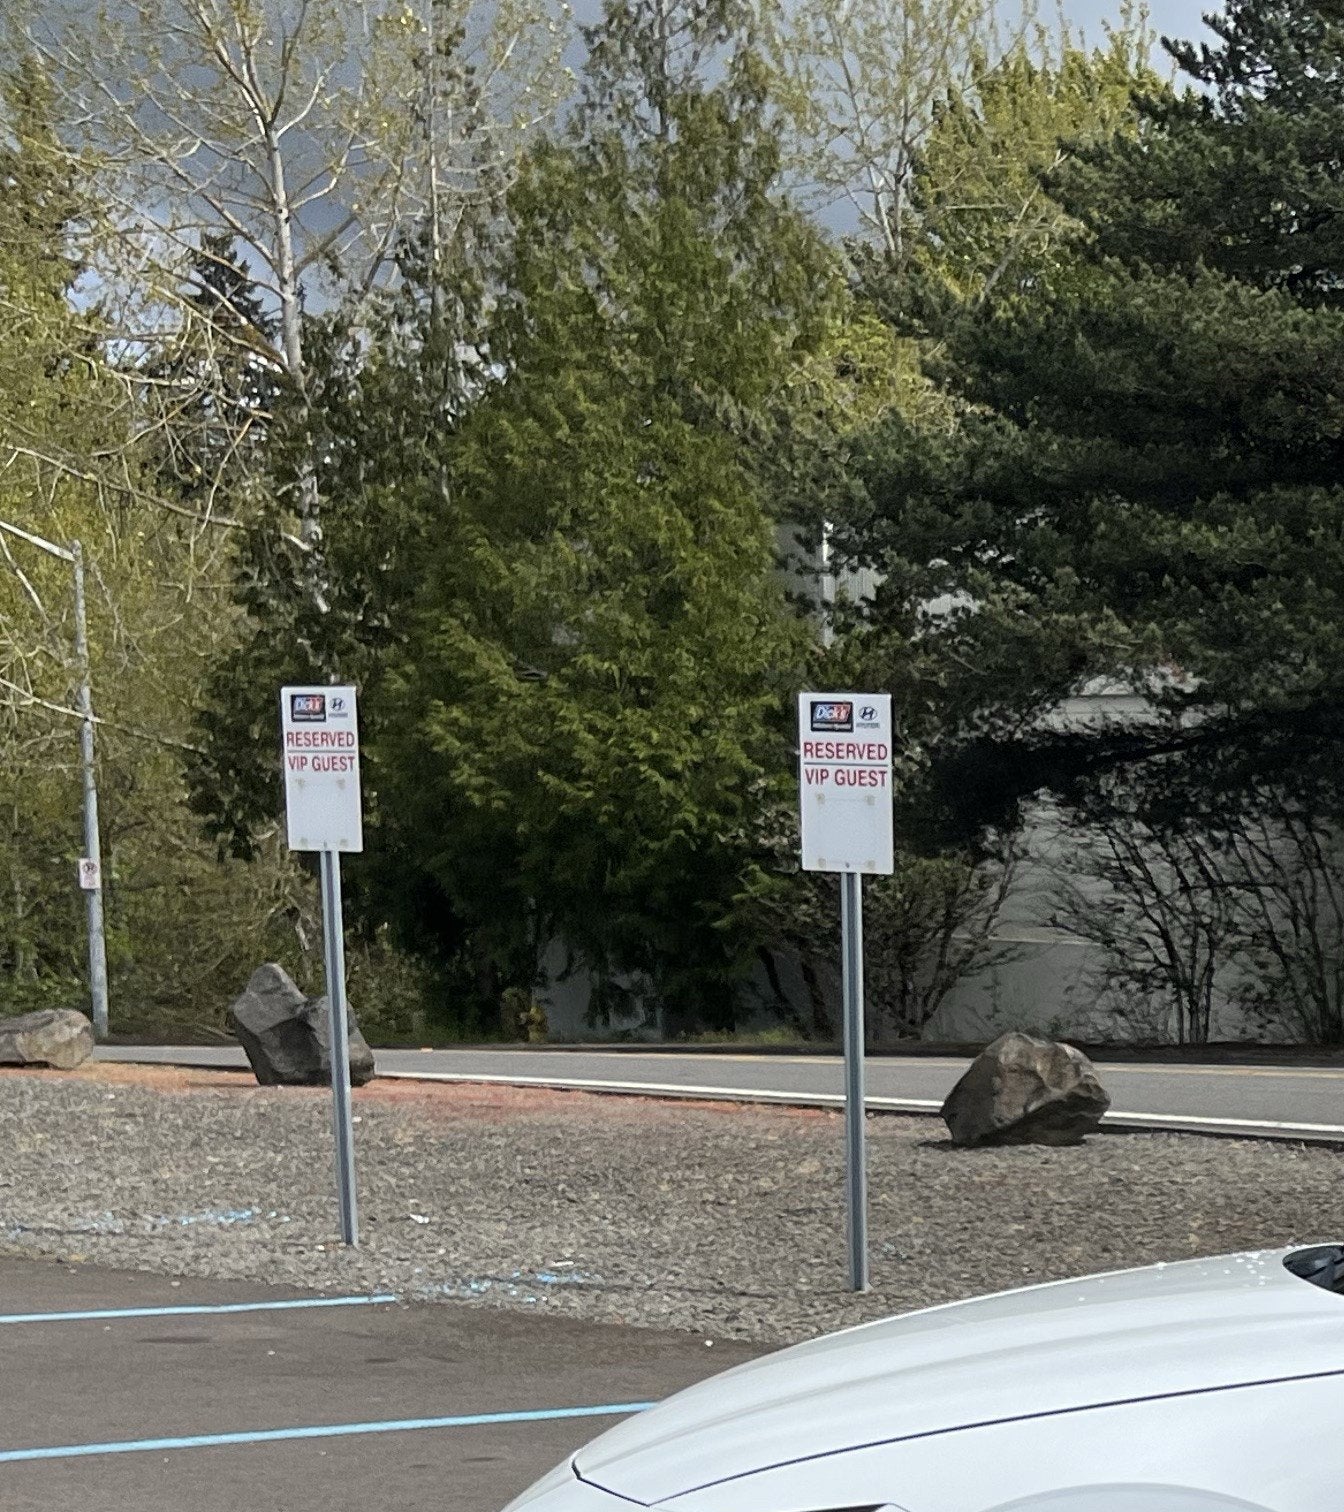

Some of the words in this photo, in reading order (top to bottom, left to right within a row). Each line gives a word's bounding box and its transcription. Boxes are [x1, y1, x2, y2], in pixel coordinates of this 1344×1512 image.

[286, 731, 355, 748] RESERVED
[803, 741, 888, 761] RESERVED
[288, 755, 308, 771] VIP
[311, 755, 356, 772] GUEST
[805, 768, 829, 786] VIP
[834, 768, 888, 787] GUEST
